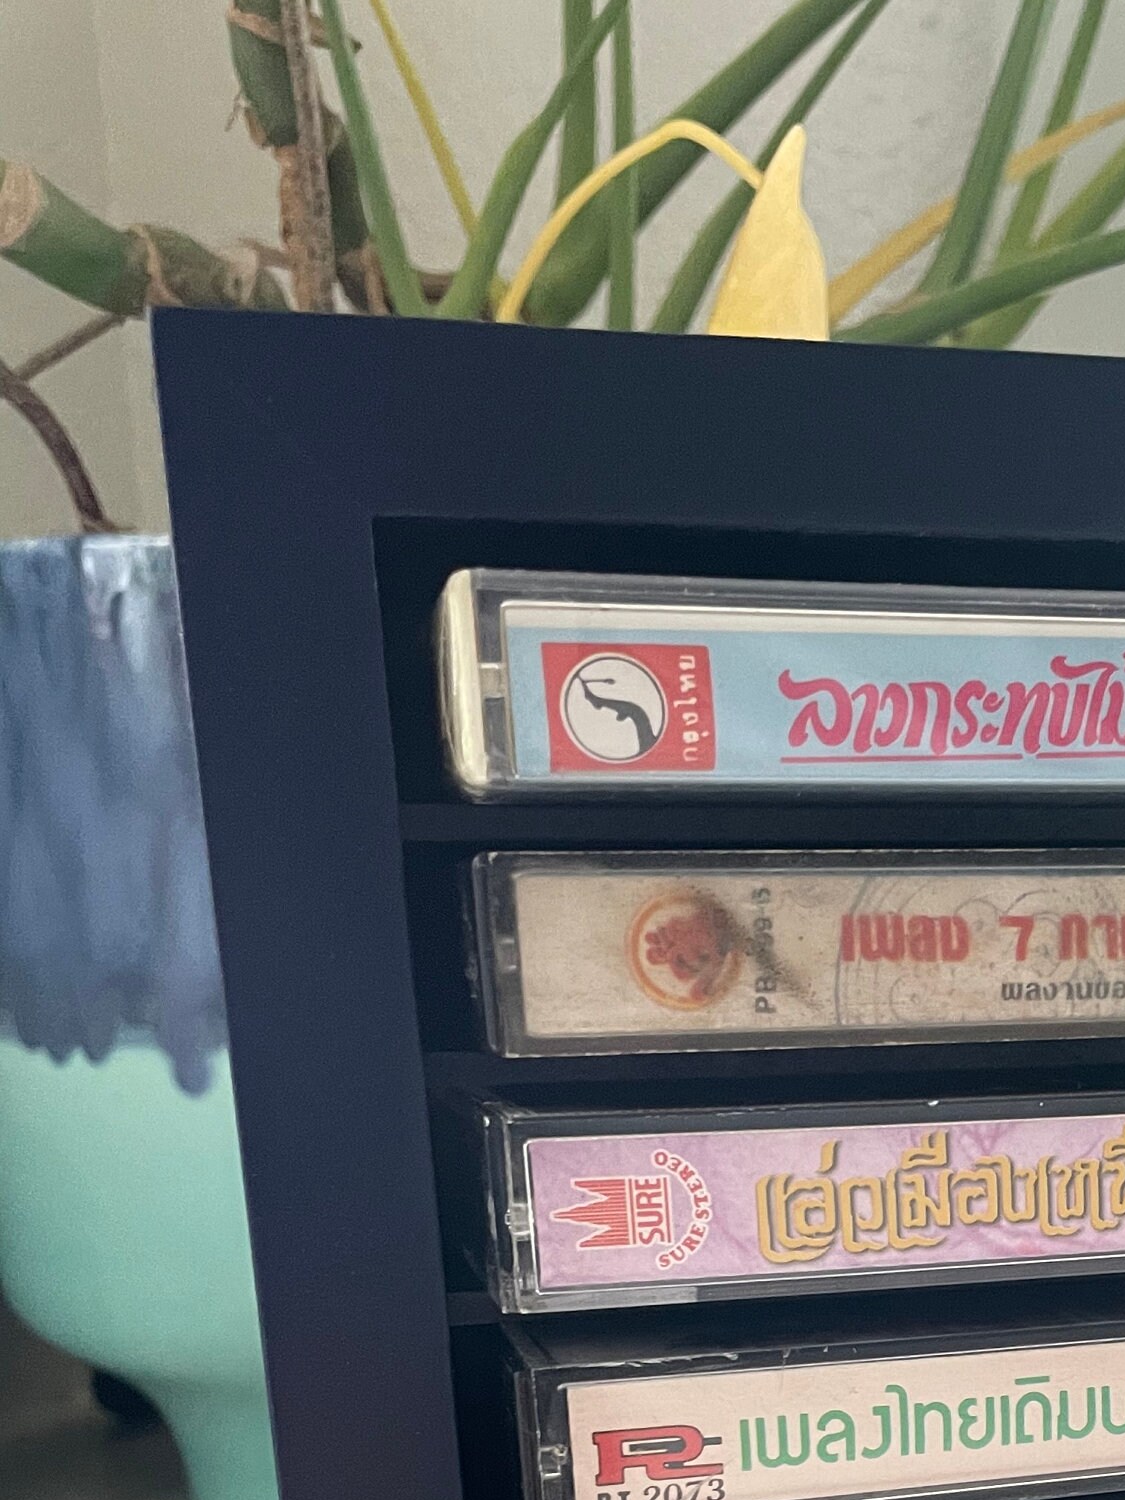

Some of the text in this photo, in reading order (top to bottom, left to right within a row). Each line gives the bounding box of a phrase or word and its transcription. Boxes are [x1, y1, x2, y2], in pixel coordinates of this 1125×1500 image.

[840, 913, 972, 963] เพลง
[1000, 915, 1035, 961] 7
[635, 1177, 666, 1245] SURE
[654, 1151, 710, 1268] SURE STEREO
